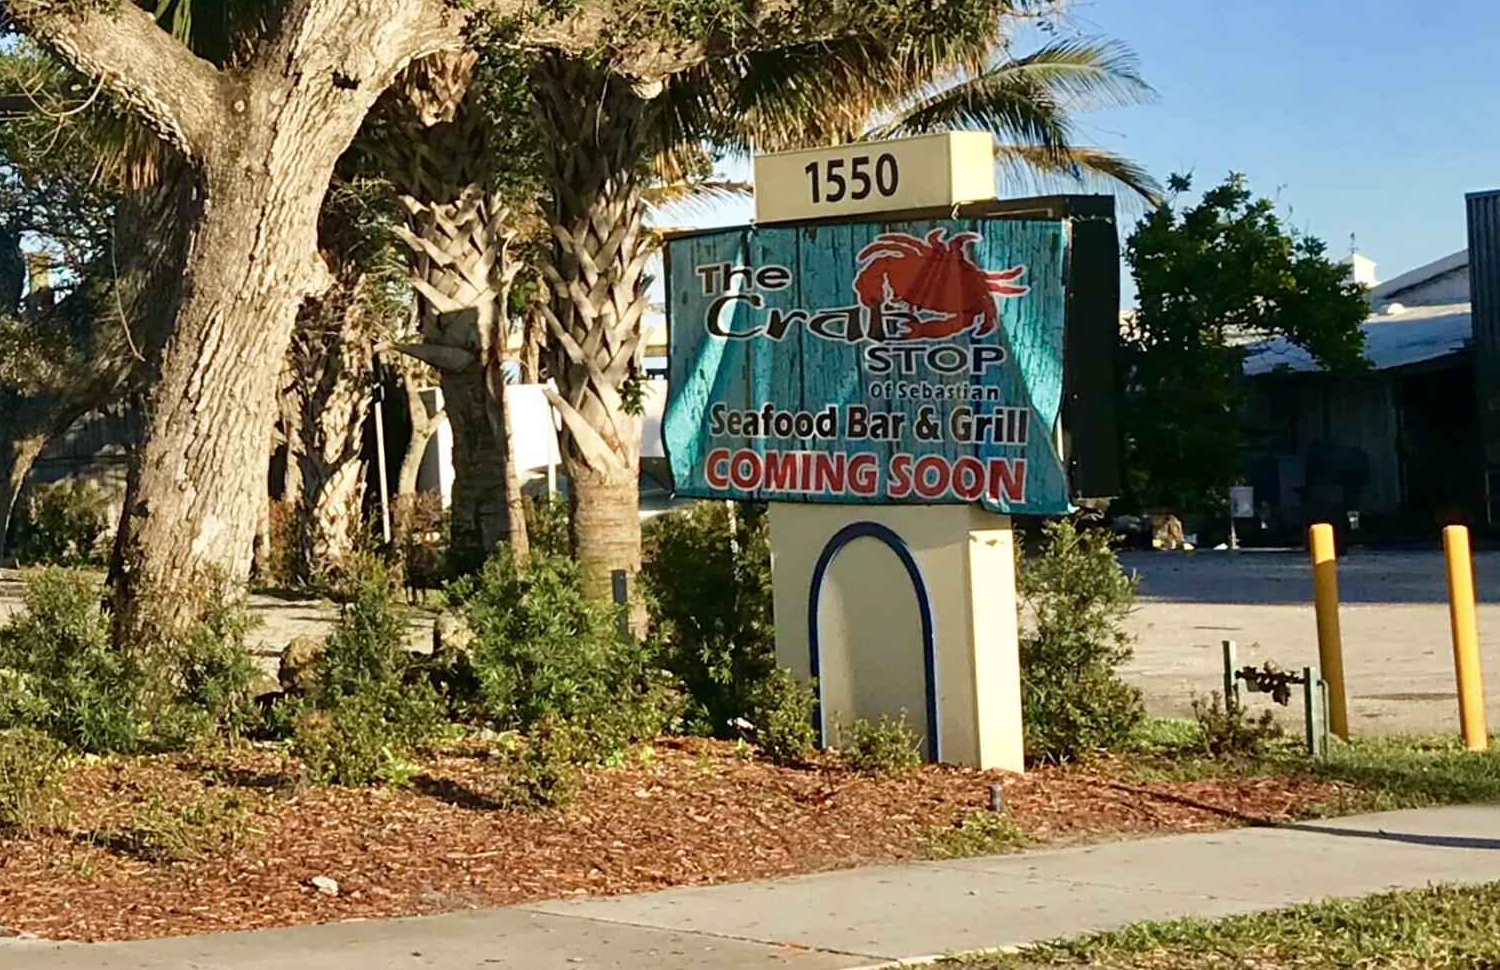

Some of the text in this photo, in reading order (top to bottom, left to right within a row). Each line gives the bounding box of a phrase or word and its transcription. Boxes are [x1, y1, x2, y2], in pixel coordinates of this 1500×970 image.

[804, 152, 900, 205] 1550
[697, 263, 791, 295] The
[705, 293, 920, 344] Crab
[866, 345, 1005, 374] STOP
[870, 381, 999, 401] Of Sebastian
[710, 402, 1028, 445] Seafood Bar & Grill
[705, 448, 1026, 503] COMING SOON
